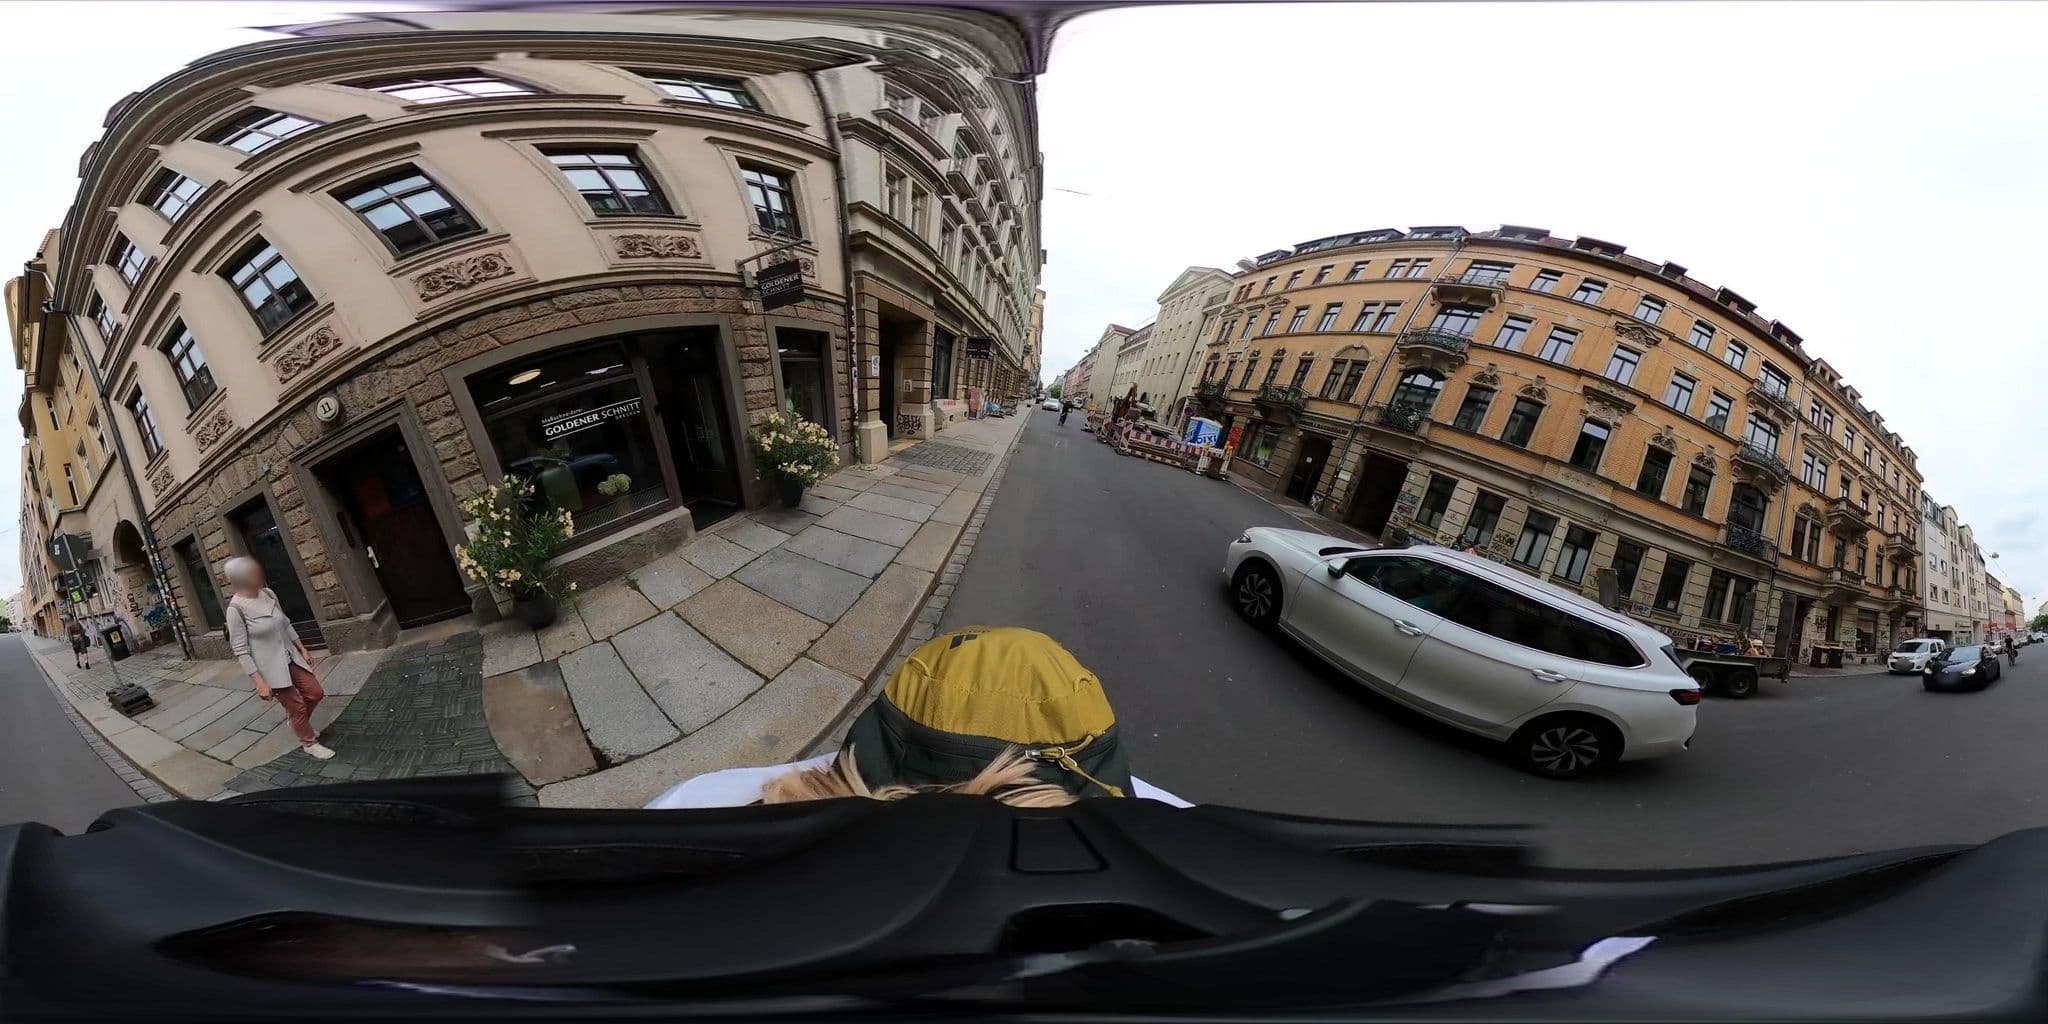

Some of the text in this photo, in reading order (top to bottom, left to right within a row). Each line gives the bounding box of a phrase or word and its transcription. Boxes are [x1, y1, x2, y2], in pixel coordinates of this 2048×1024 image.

[761, 274, 799, 290] GOLDENER
[762, 283, 790, 295] SCHNITT
[320, 401, 333, 415] 11
[545, 401, 640, 436] GOLDENER SCHNITT
